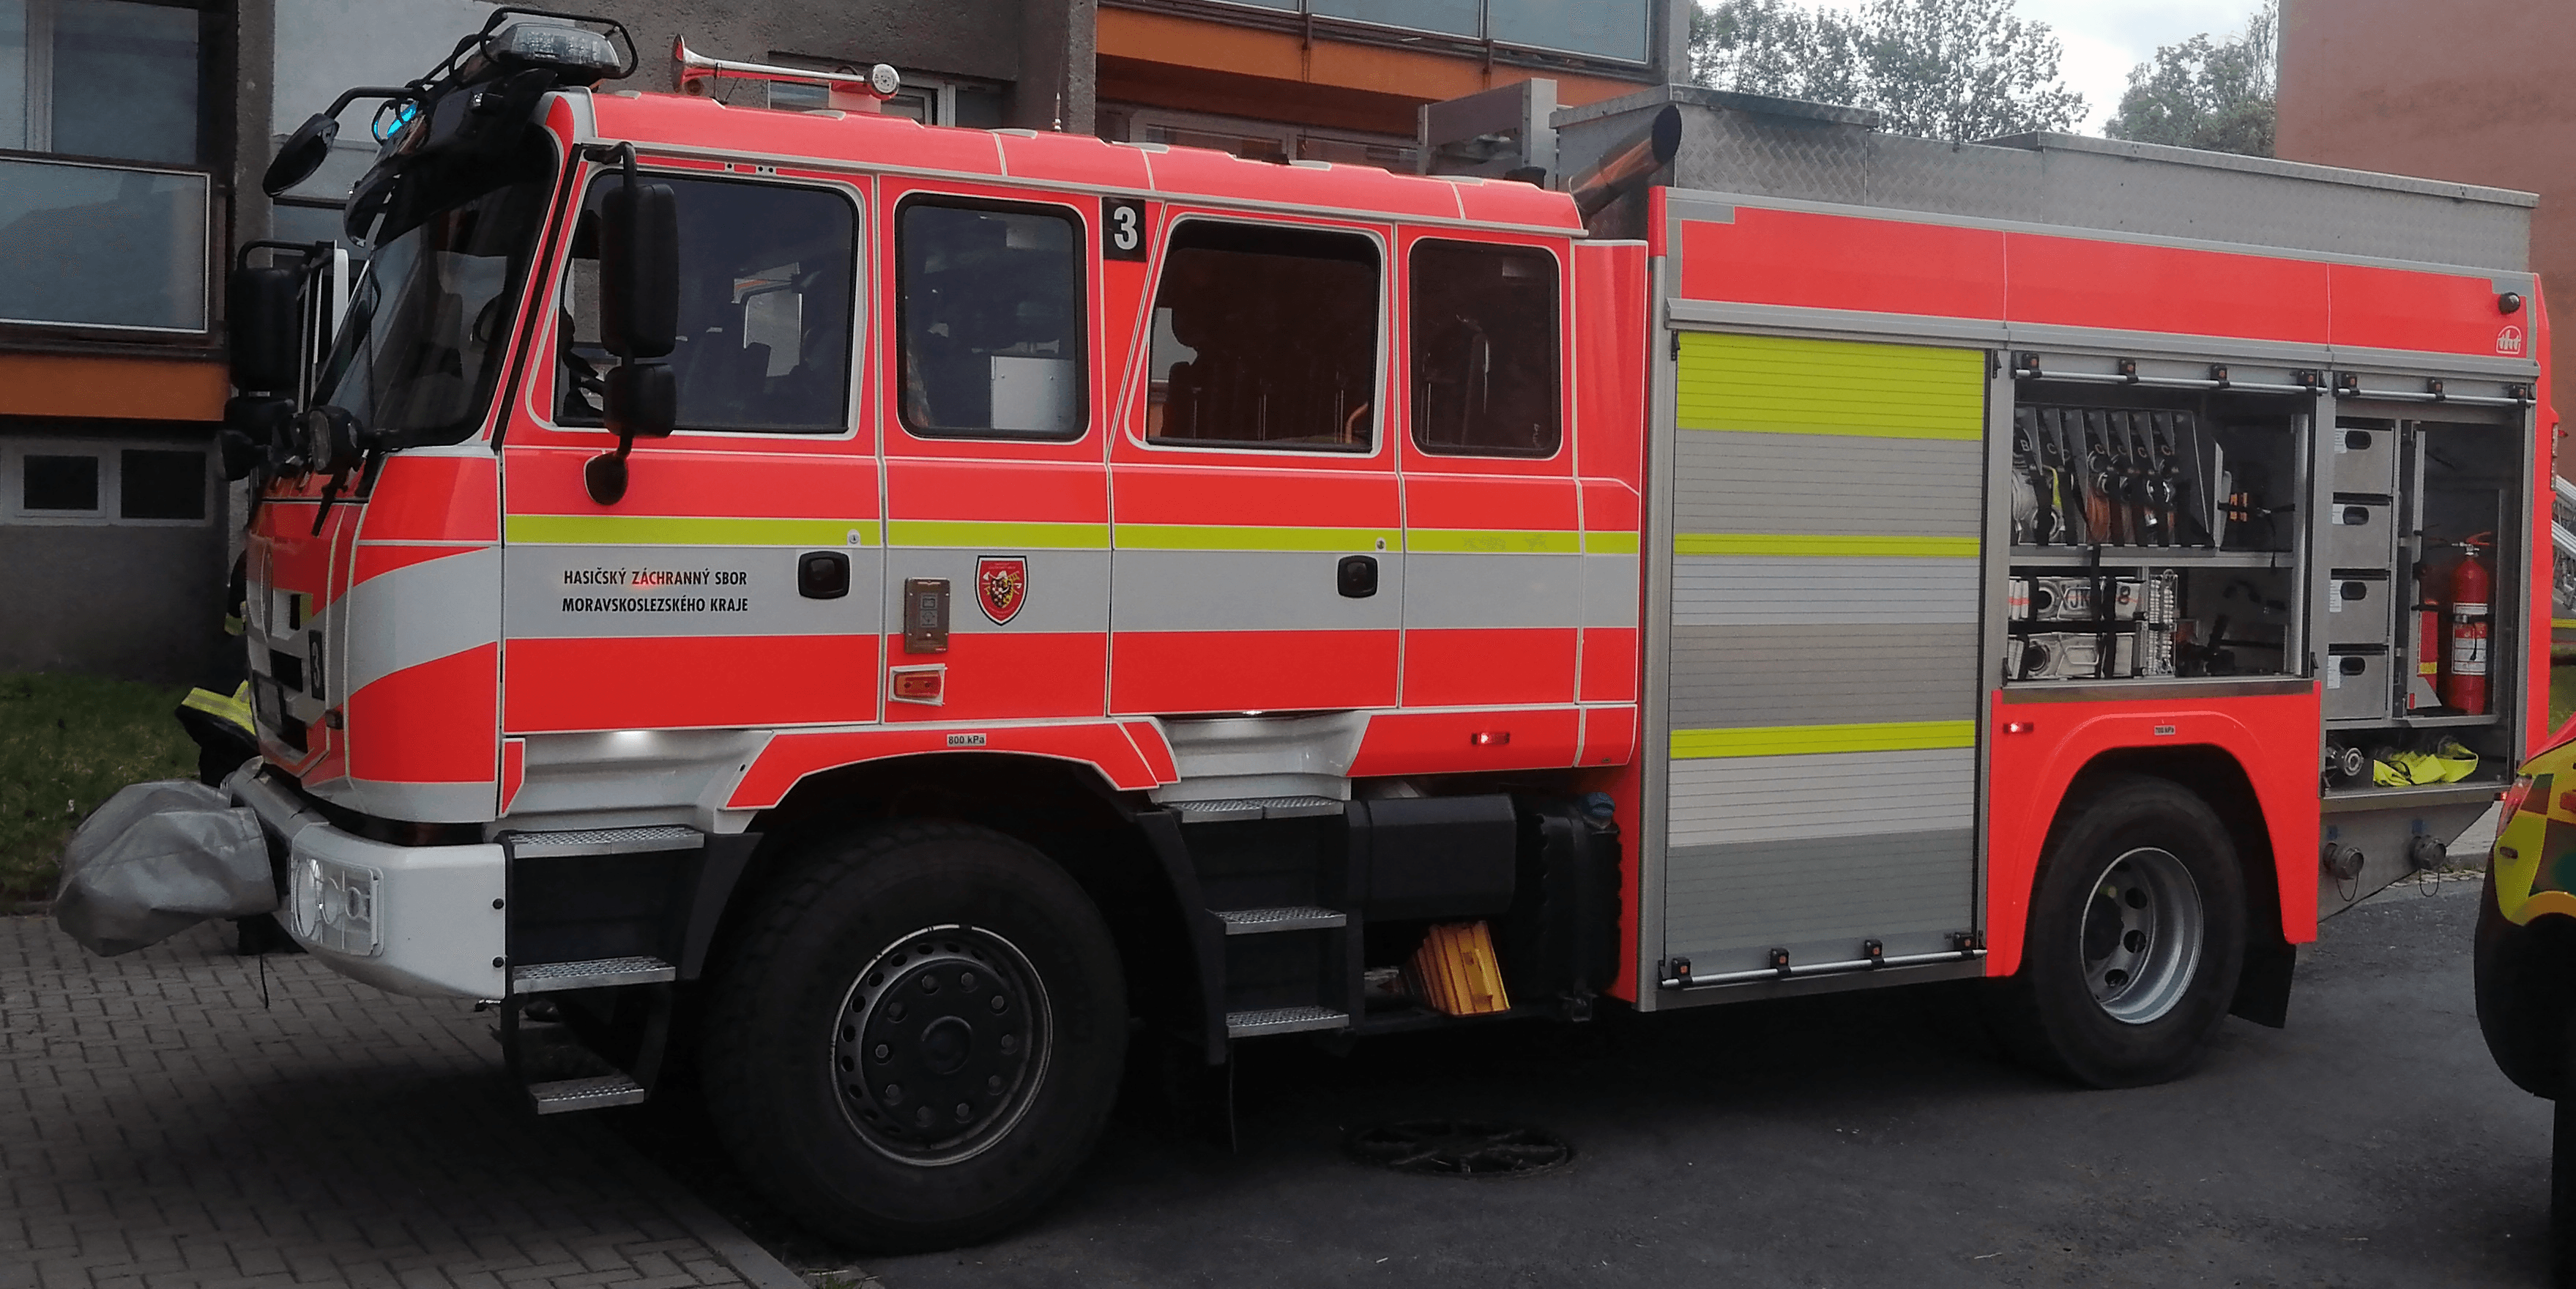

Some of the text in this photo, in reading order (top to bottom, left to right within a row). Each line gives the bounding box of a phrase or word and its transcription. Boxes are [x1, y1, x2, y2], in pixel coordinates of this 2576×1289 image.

[1114, 206, 1138, 250] 3
[2020, 439, 2030, 451] B
[2047, 443, 2057, 454] C
[2095, 444, 2105, 455] C
[2161, 445, 2172, 456] C
[2137, 447, 2148, 458] C
[564, 568, 747, 585] HASIČSKÝ ZÁCHRANNÝ SBOR
[562, 595, 748, 612] MORAVSKOSLEZSKÉHO KRAJE
[312, 641, 320, 688] 3
[948, 735, 985, 744] 800 kPa
